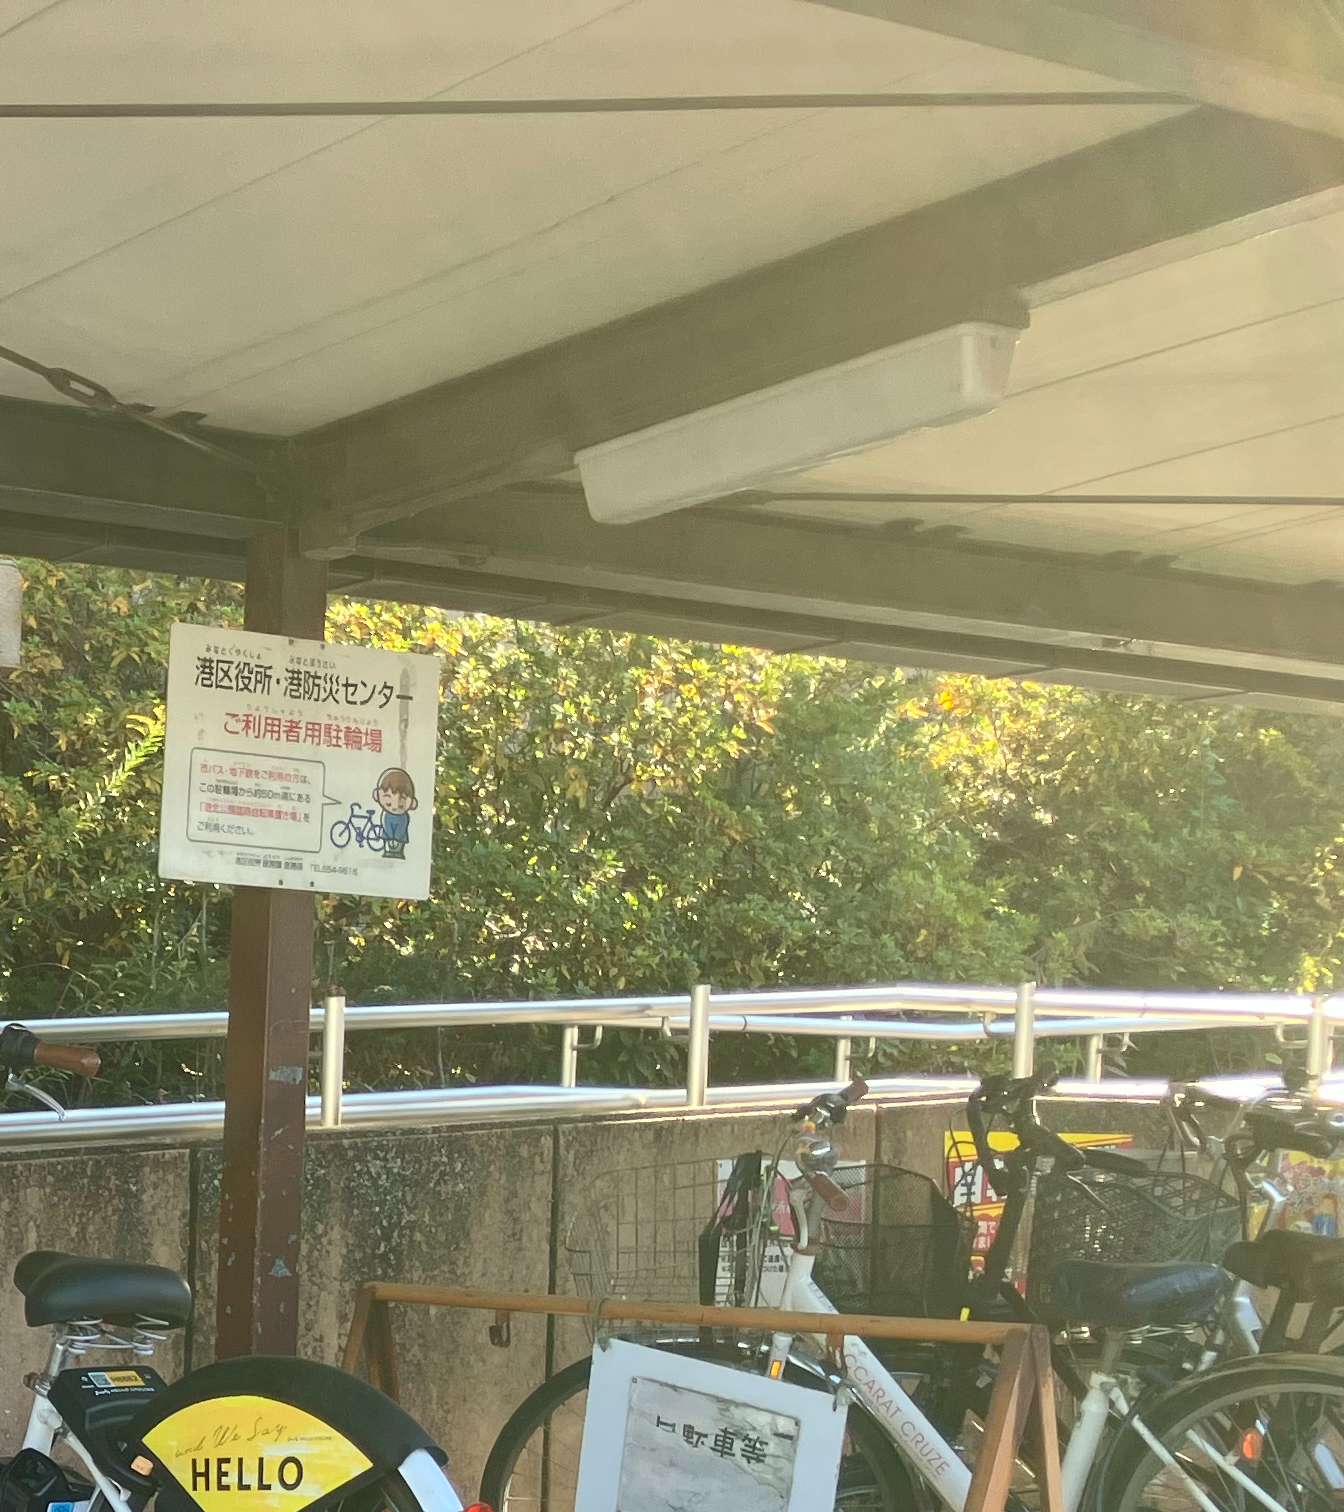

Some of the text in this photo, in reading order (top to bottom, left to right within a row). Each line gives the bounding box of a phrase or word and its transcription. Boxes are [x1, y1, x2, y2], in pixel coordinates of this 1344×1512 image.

[194, 656, 414, 709] 港区役所・港防災センター
[223, 711, 384, 753] ご利用者用駐輪場
[844, 1353, 950, 1477] CCARAT CRUZE
[175, 1416, 288, 1458] and We Say
[191, 1456, 304, 1492] HELLO
